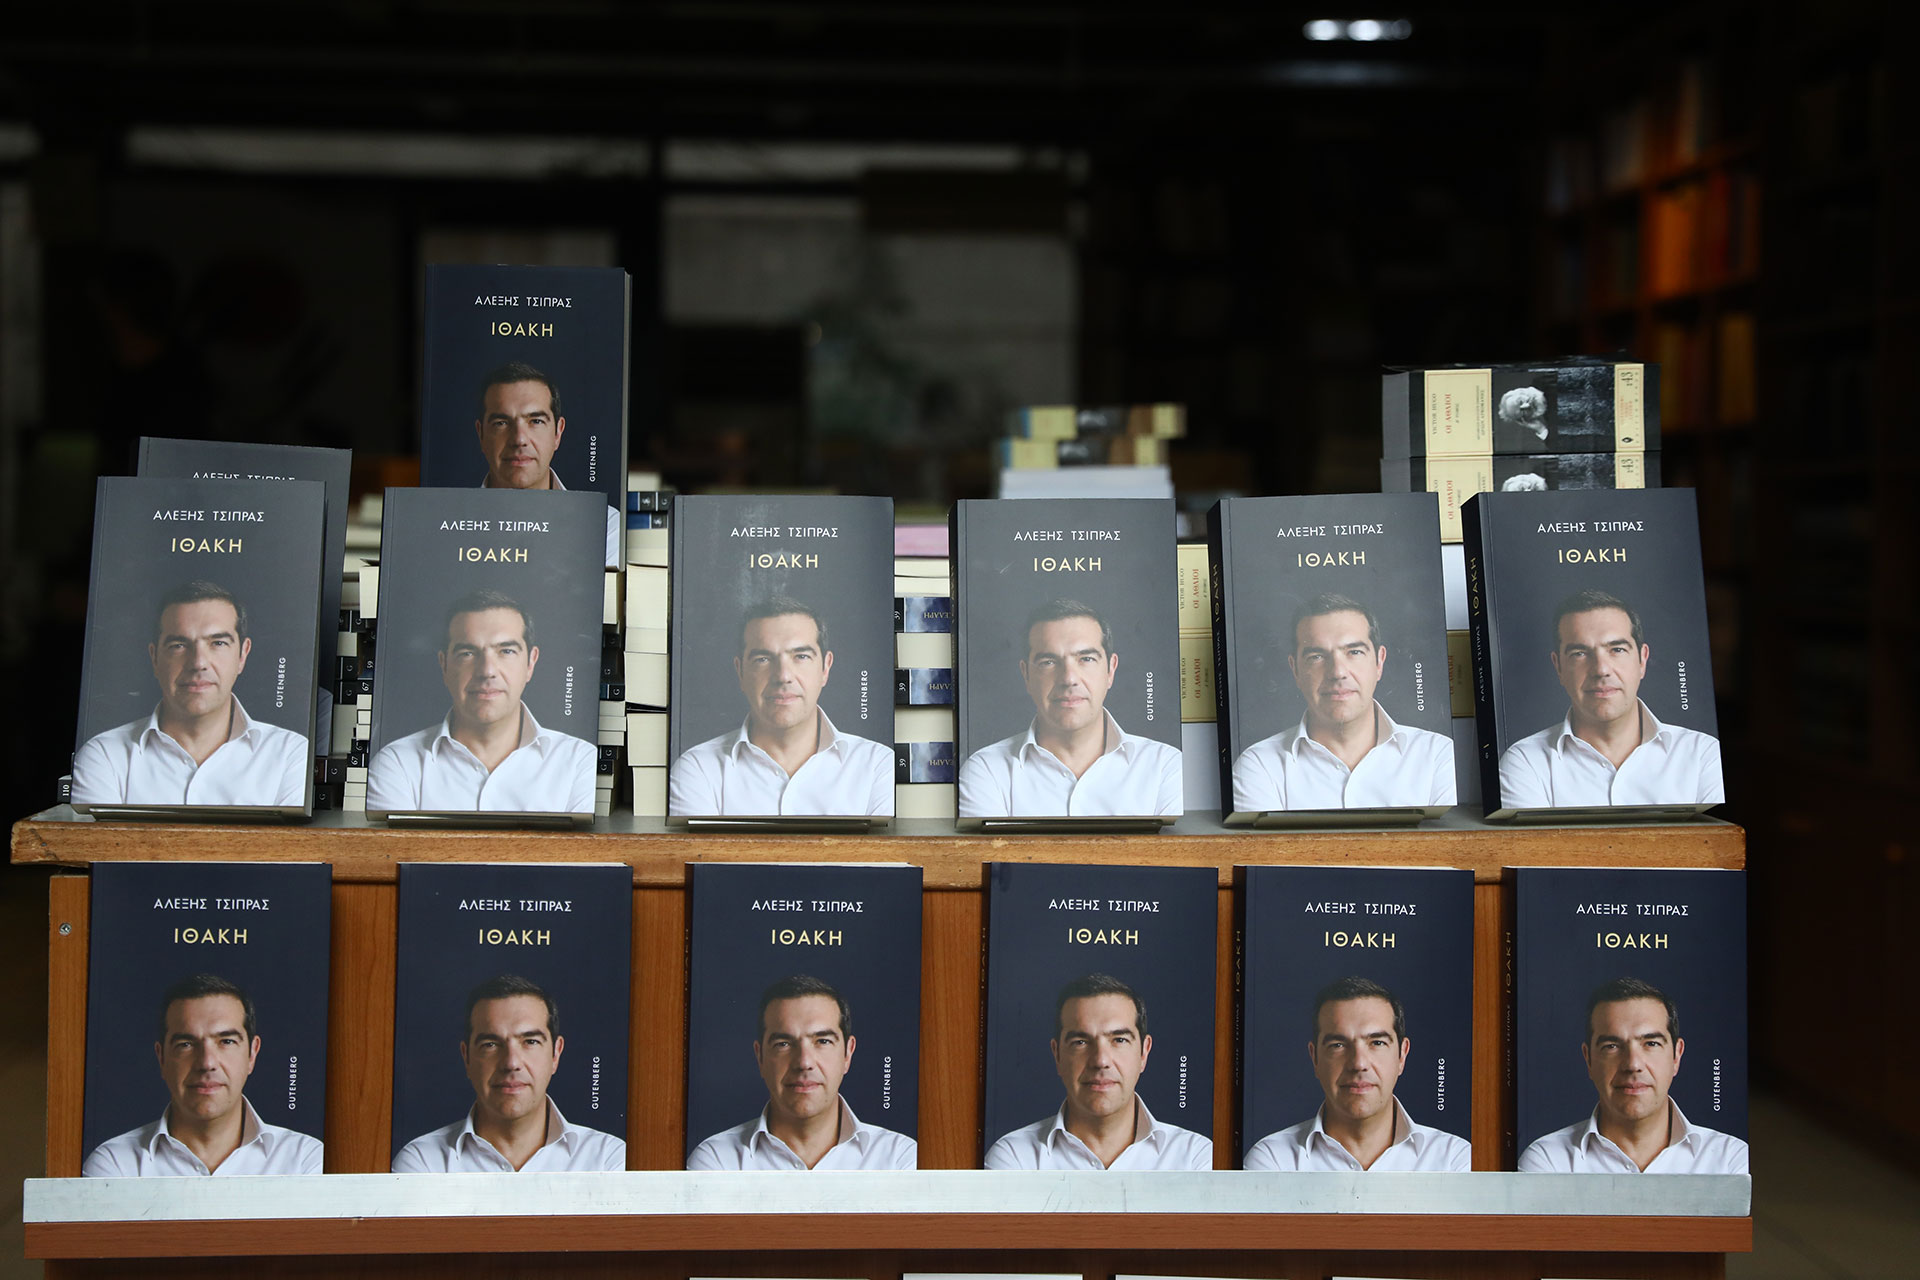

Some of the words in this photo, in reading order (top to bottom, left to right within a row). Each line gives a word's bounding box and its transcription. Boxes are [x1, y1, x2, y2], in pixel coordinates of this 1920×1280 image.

[475, 296, 519, 306] ΑΛΕΞΗΣ
[527, 297, 571, 307] ΤΣΙΠΡΑΣ
[492, 322, 552, 337] ΙΘΑΚΗ
[153, 510, 204, 521] ΑΛΕΞΗΣ
[213, 511, 264, 521] ΤΣΙΠΡΑΣ
[440, 521, 490, 531] ΑΛΕΞΗΣ
[499, 521, 549, 532] ΤΣΙΠΡΑΣ
[731, 527, 780, 537] ΑΛΕΞΗΣ
[788, 527, 838, 537] ΤΣΙΠΡΑΣ
[1277, 526, 1326, 537] ΑΛΕΞΗΣ
[1334, 524, 1383, 535] ΤΣΙΠΡΑΣ
[1538, 522, 1586, 533] ΑΛΕΞΗΣ
[1594, 521, 1643, 531] ΤΣΙΠΡΑΣ
[1013, 531, 1064, 541] ΑΛΕΞΗΣ
[1071, 531, 1121, 541] ΤΣΙΠΡΑΣ
[172, 538, 241, 553] ΙΘΑΚΗ
[459, 548, 527, 562] ΙΘΑΚΗ
[751, 552, 818, 568] ΙΘΑΚΗ
[1298, 551, 1365, 567] ΙΘΑΚΗ
[1559, 548, 1626, 563] ΙΘΑΚΗ
[1034, 557, 1101, 571] ΙΘΑΚΗ
[1470, 557, 1480, 616] ΙΘΑΚΗ
[1193, 599, 1199, 608] ΟΙ
[276, 656, 286, 708] GUTENBERG
[361, 682, 369, 691] 67
[1416, 661, 1425, 711] GUTENBERG
[1679, 660, 1688, 710] GUTENBERG
[565, 666, 573, 715] GUTENBERG
[1195, 689, 1201, 698] ΟΙ
[351, 756, 359, 765] 67
[154, 899, 206, 909] ΑΛΕΞΗΣ
[216, 899, 269, 910] ΤΣΙΠΡΑΣ
[459, 900, 511, 910] ΑΛΕΞΗΣ
[520, 900, 571, 912] ΤΣΙΠΡΑΣ
[752, 900, 803, 911] ΑΛΕΞΗΣ
[812, 901, 863, 912] ΤΣΙΠΡΑΣ
[1049, 899, 1099, 910] ΑΛΕΞΗΣ
[1108, 900, 1159, 912] ΤΣΙΠΡΑΣ
[1305, 902, 1356, 913] ΑΛΕΞΗΣ
[1364, 904, 1416, 915] ΤΣΙΠΡΑΣ
[1576, 904, 1628, 915] ΑΛΕΞΗΣ
[1636, 905, 1688, 916] ΤΣΙΠΡΑΣ
[175, 928, 247, 944] ΙΘΑΚΗ
[479, 929, 550, 945] ΙΘΑΚΗ
[772, 930, 841, 945] ΙΘΑΚΗ
[1069, 928, 1138, 945] ΙΘΑΚΗ
[1326, 932, 1395, 948] ΙΘΑΚΗ
[1598, 933, 1667, 948] ΙΘΑΚΗ
[289, 1057, 297, 1109] GUTENBERG
[592, 1057, 600, 1109] GUTENBERG
[883, 1057, 891, 1109] GUTENBERG
[1179, 1056, 1187, 1108] GUTENBERG
